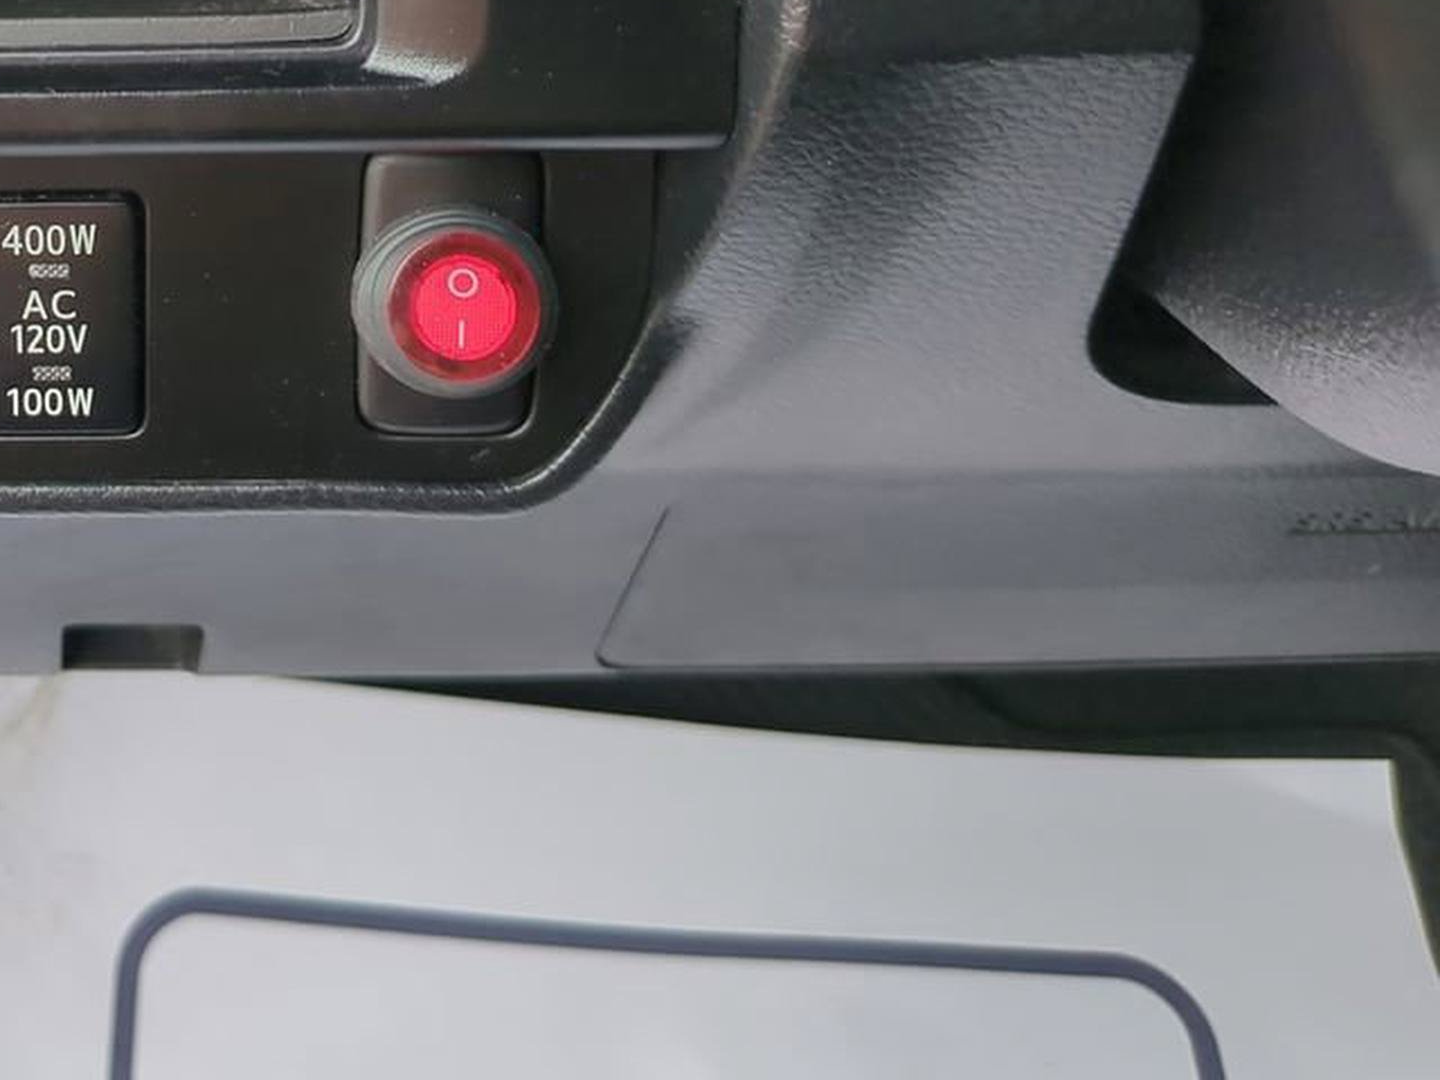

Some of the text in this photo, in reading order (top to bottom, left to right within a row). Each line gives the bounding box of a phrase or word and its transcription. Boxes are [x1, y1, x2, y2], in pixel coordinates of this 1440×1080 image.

[1, 223, 97, 256] 400W
[22, 289, 77, 320] AC
[10, 324, 87, 354] 120V
[6, 387, 93, 417] 100W
